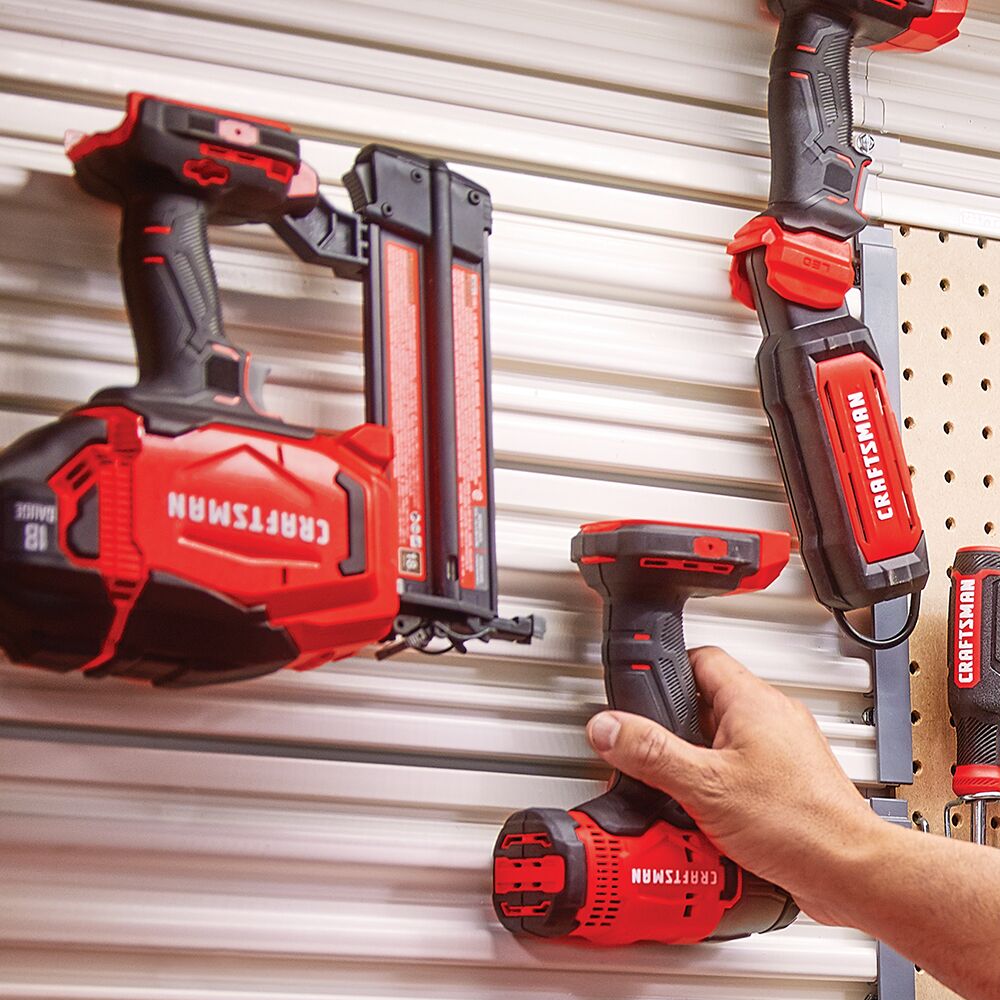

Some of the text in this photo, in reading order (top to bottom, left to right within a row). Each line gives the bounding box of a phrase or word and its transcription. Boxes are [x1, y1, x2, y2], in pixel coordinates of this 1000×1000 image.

[847, 391, 894, 521] CRAFTSMAN
[24, 523, 49, 552] 18
[168, 491, 331, 545] CRAFTSMAN
[957, 578, 976, 684] CRAFTSMAN
[631, 867, 718, 886] CRAFTSMAN
